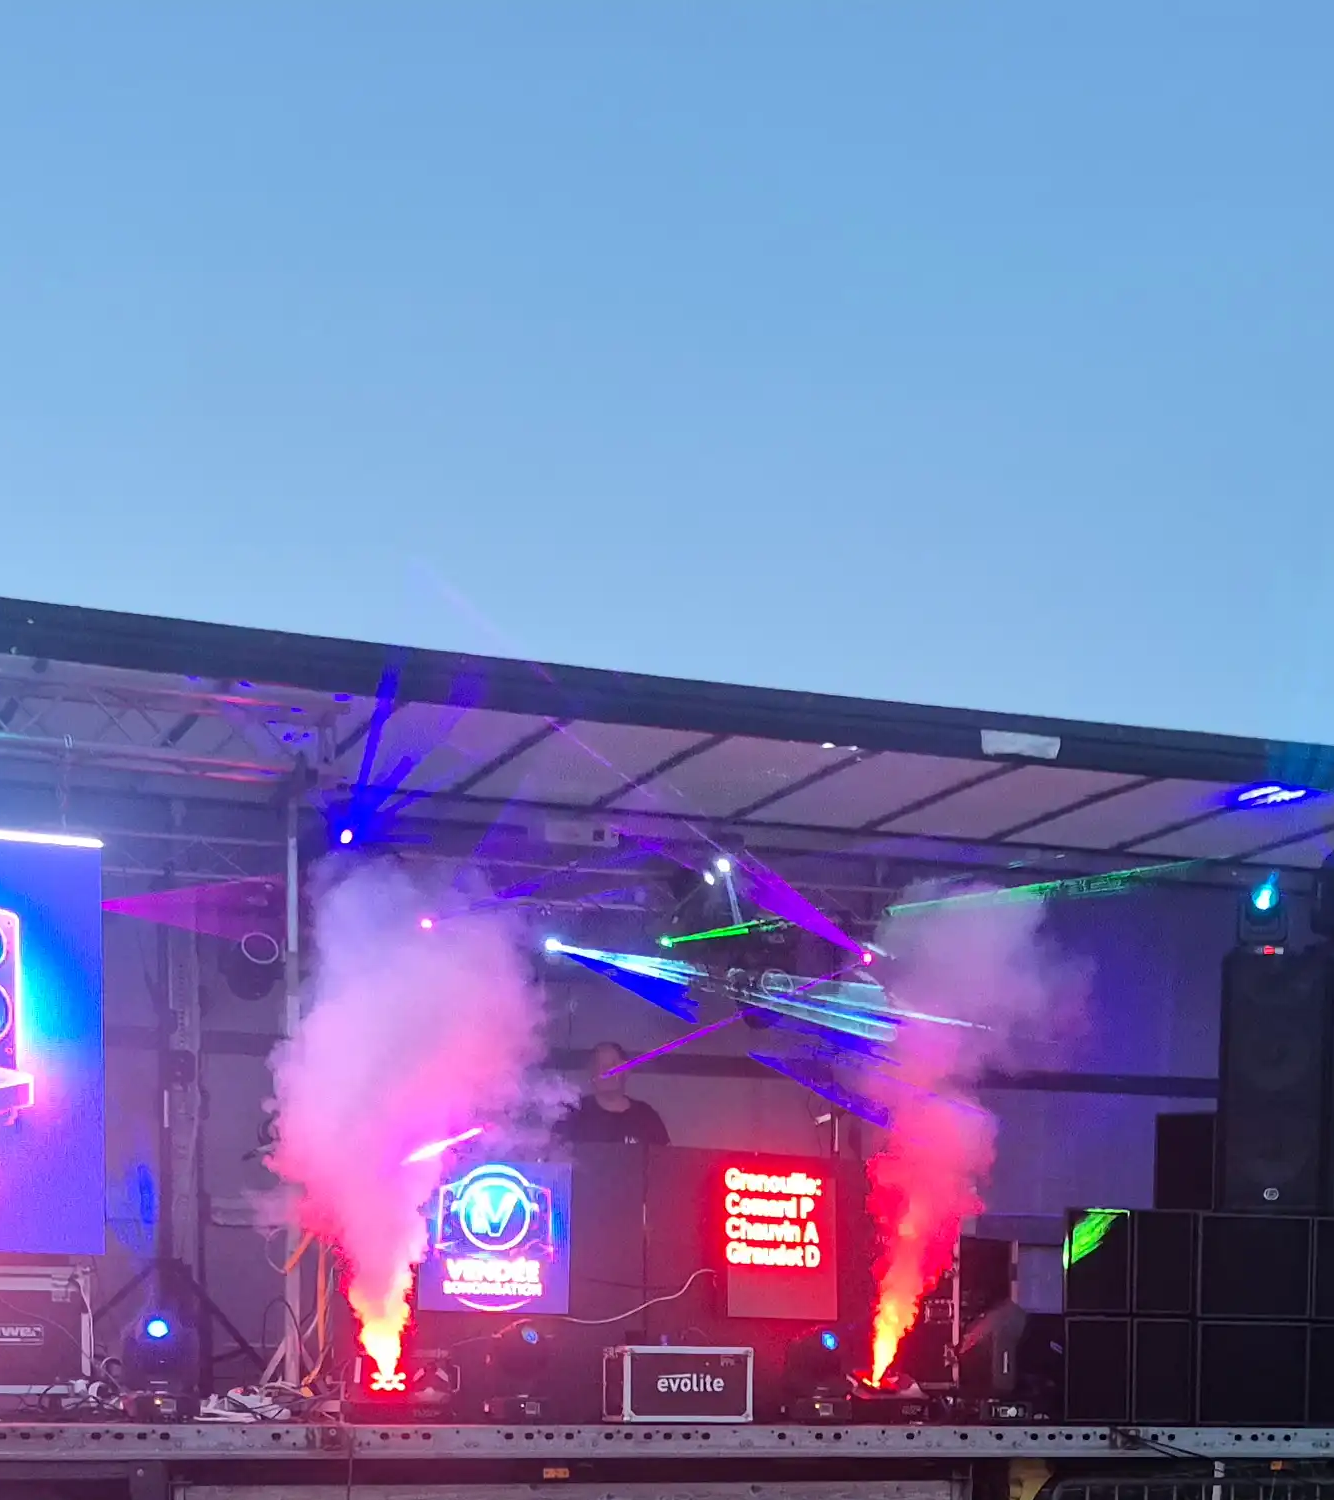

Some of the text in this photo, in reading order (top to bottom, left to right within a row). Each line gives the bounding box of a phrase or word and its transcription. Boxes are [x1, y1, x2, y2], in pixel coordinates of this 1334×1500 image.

[800, 1196, 815, 1219] P
[725, 1216, 820, 1244] Chauvin A
[805, 1244, 821, 1268] D
[656, 1374, 725, 1392] evolite
